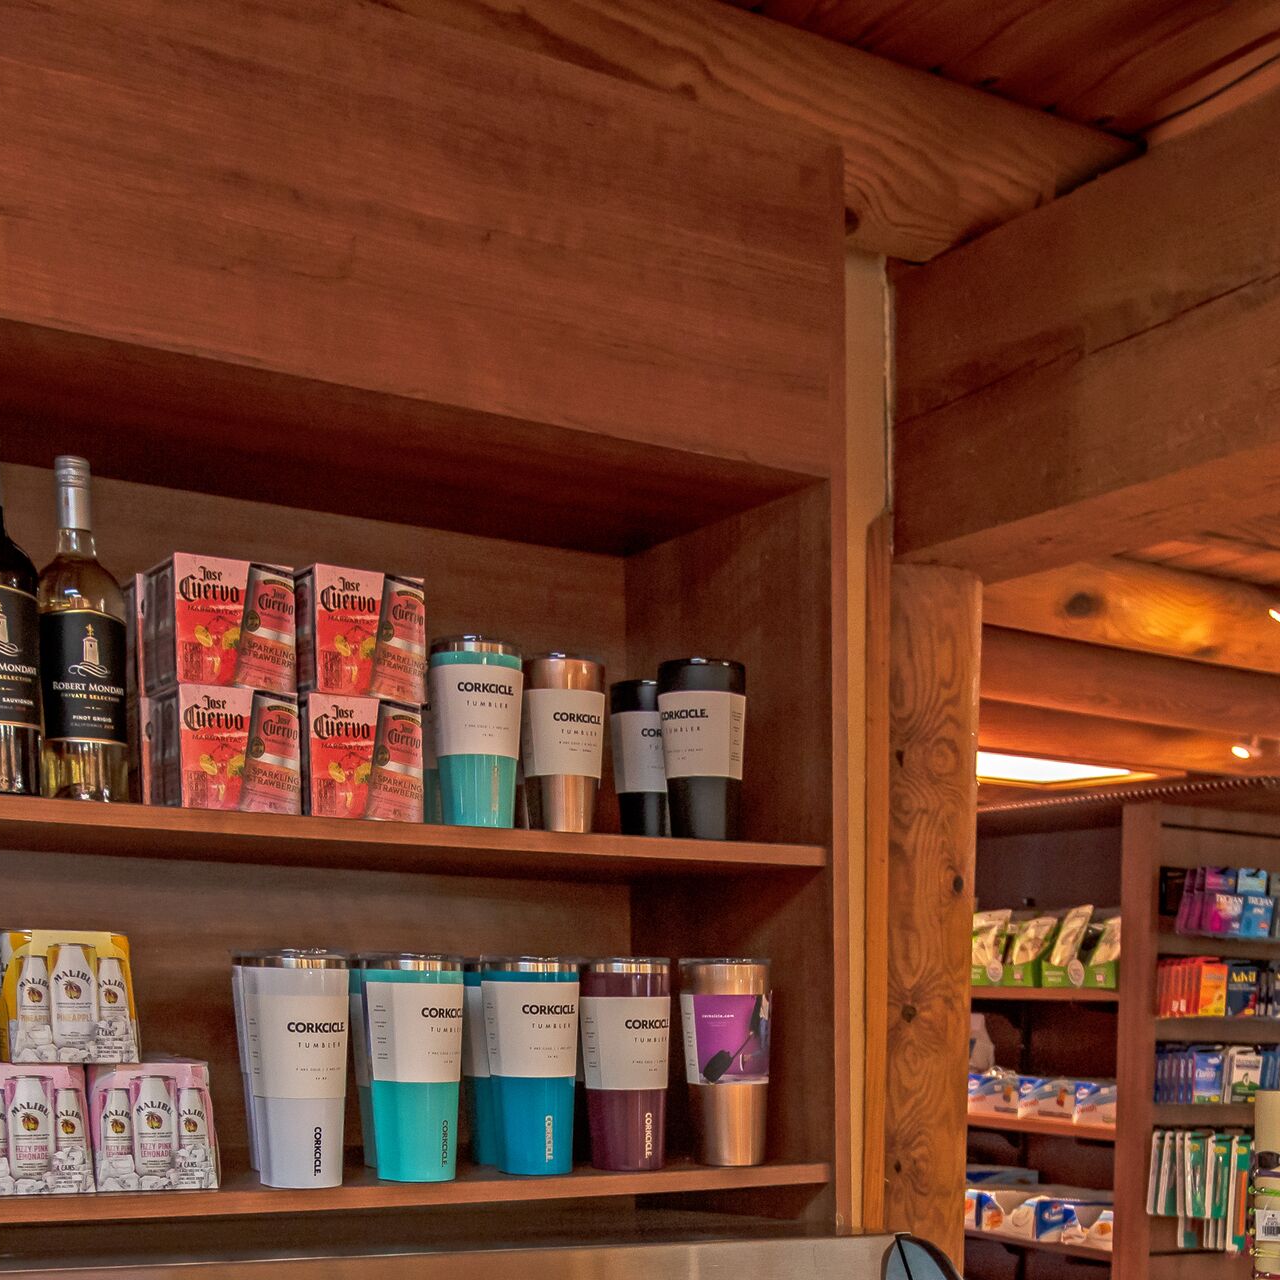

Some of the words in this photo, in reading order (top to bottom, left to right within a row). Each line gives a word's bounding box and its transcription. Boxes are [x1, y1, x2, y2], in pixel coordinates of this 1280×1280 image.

[199, 566, 222, 582] Jose
[179, 575, 239, 604] Cuervo
[320, 586, 376, 613] Cuervo
[0, 675, 32, 683] SELECTION
[53, 680, 86, 691] ROBERT
[89, 684, 124, 696] MONDAVI
[458, 681, 513, 696] CORKCICLE.
[2, 697, 33, 705] SAUVIGNON
[202, 695, 226, 710] Jose
[466, 700, 509, 709] TUMBLER
[184, 704, 244, 731] Cuervo
[1231, 971, 1256, 983] Advil
[522, 1004, 576, 1016] CORKCICLE.
[287, 1022, 345, 1034] CORKCICLE.
[12, 1101, 50, 1118] MALIBU
[314, 1126, 322, 1176] CORKCICLE.
